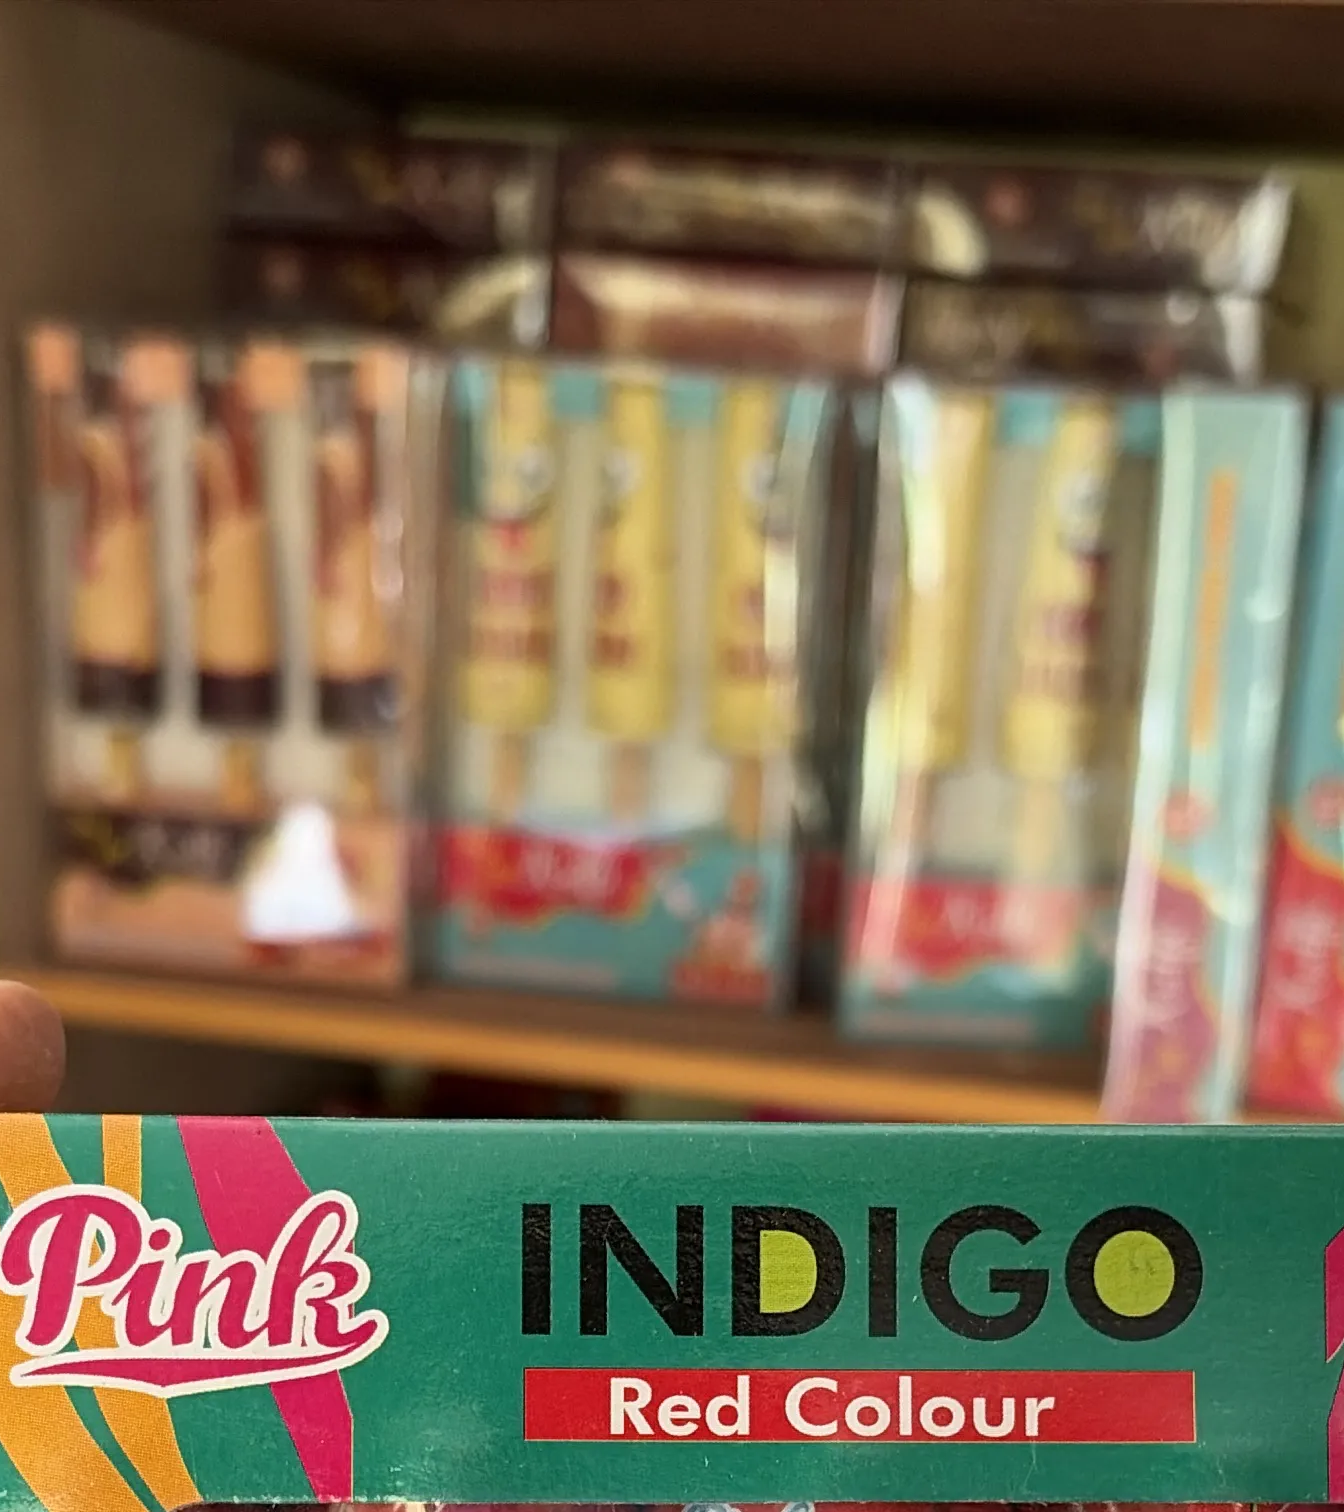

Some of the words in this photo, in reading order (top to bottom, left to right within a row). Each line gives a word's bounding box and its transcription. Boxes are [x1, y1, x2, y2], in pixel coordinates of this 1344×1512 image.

[521, 1203, 1203, 1341] INDIGO
[610, 1375, 750, 1436] Red
[784, 1375, 1055, 1437] Colour
